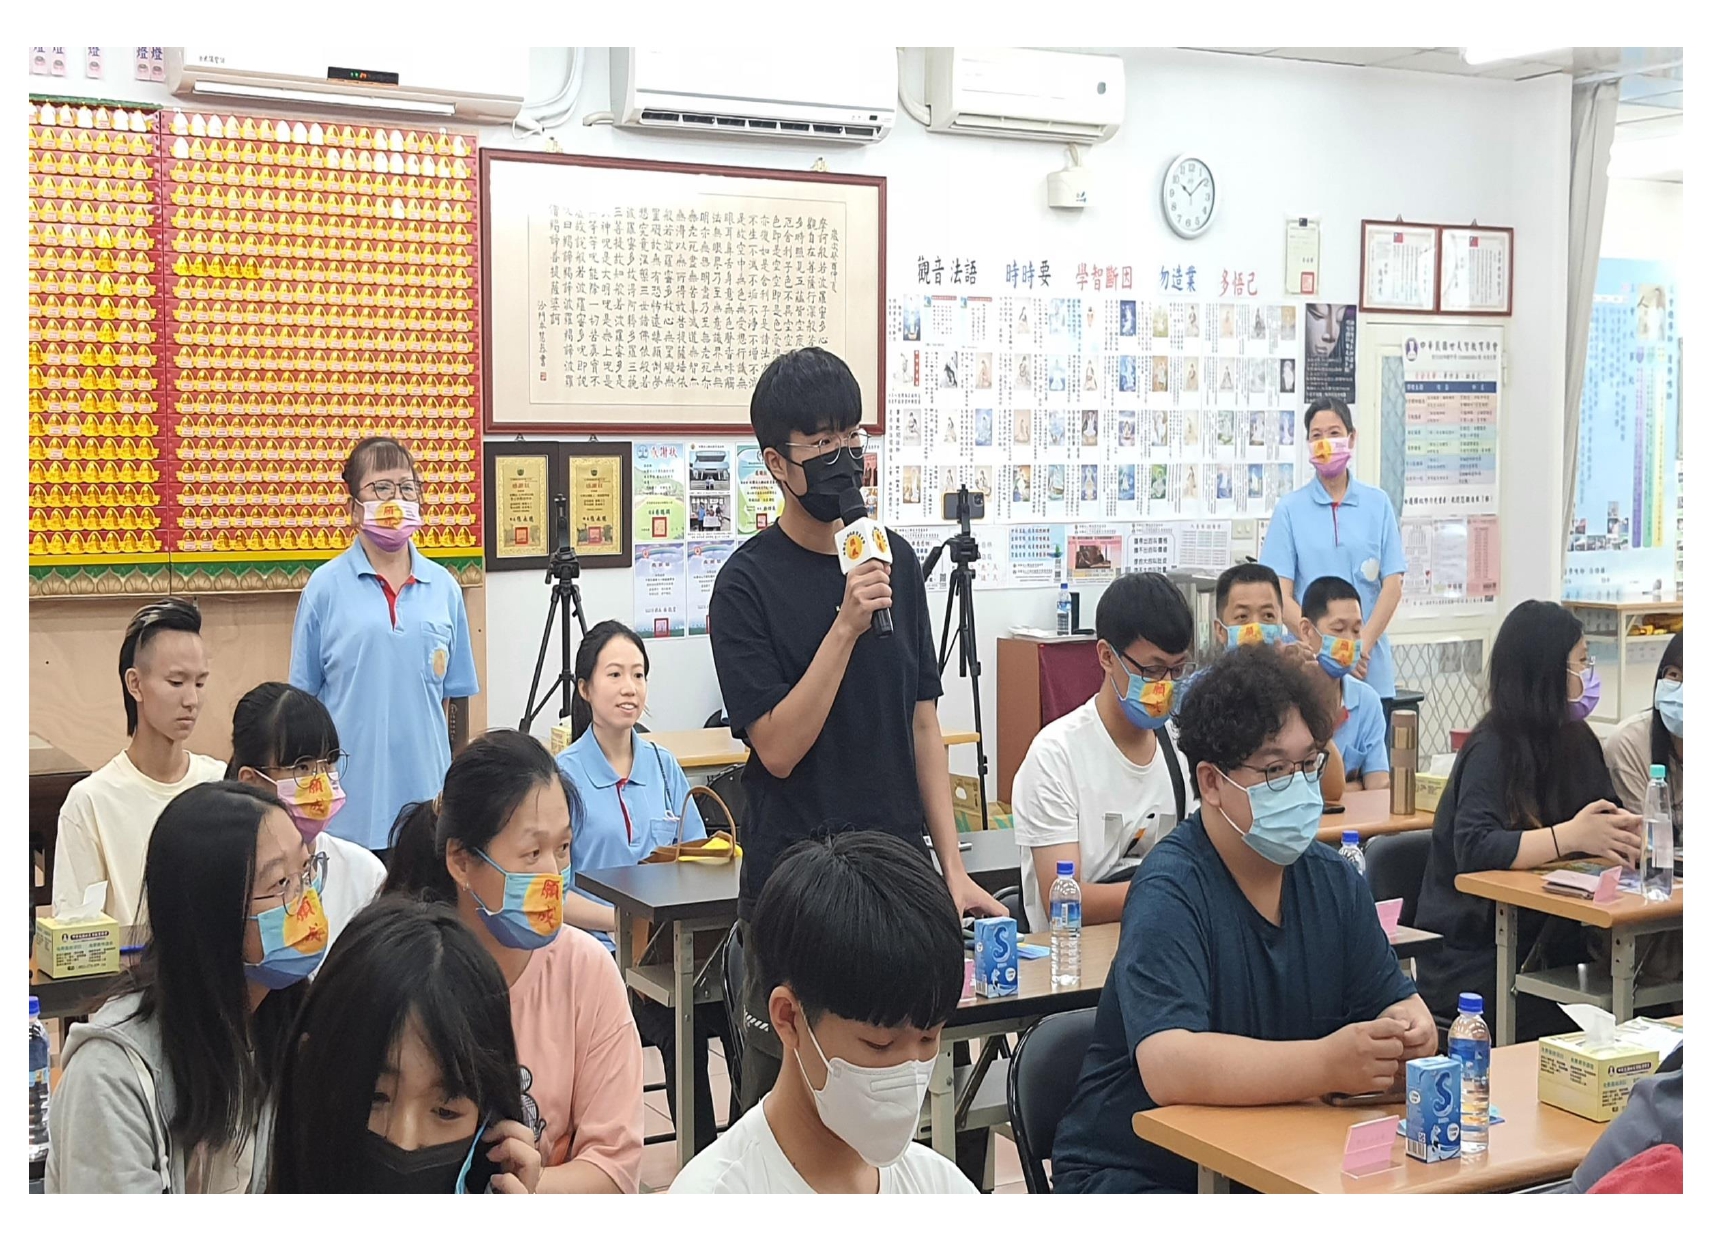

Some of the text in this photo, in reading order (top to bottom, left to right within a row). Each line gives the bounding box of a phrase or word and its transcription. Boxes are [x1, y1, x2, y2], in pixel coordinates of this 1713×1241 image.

[917, 255, 978, 285] 觀音法語
[1005, 260, 1051, 289] 時時要
[1075, 262, 1133, 292] 學智斷因
[1159, 264, 1197, 292] 勿造業
